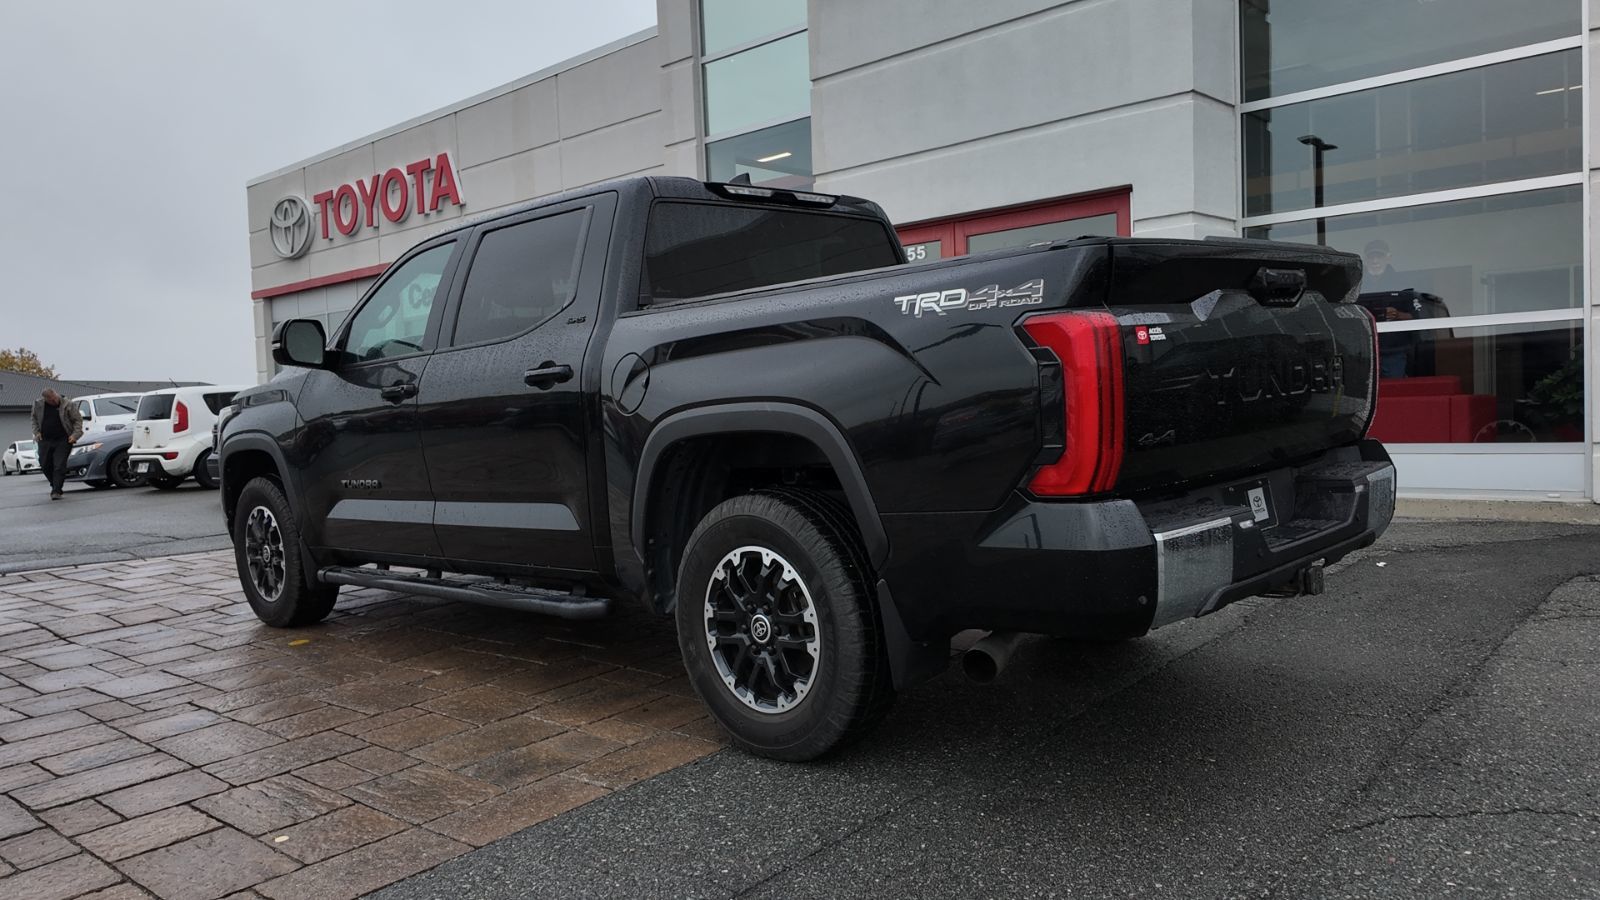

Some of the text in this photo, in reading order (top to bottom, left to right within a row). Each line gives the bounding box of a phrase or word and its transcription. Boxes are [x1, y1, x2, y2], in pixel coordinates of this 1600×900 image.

[313, 152, 464, 240] TOYOTA
[907, 246, 926, 262] 55
[894, 279, 1044, 318] TRD 4x4
[999, 297, 1043, 308] ROAD
